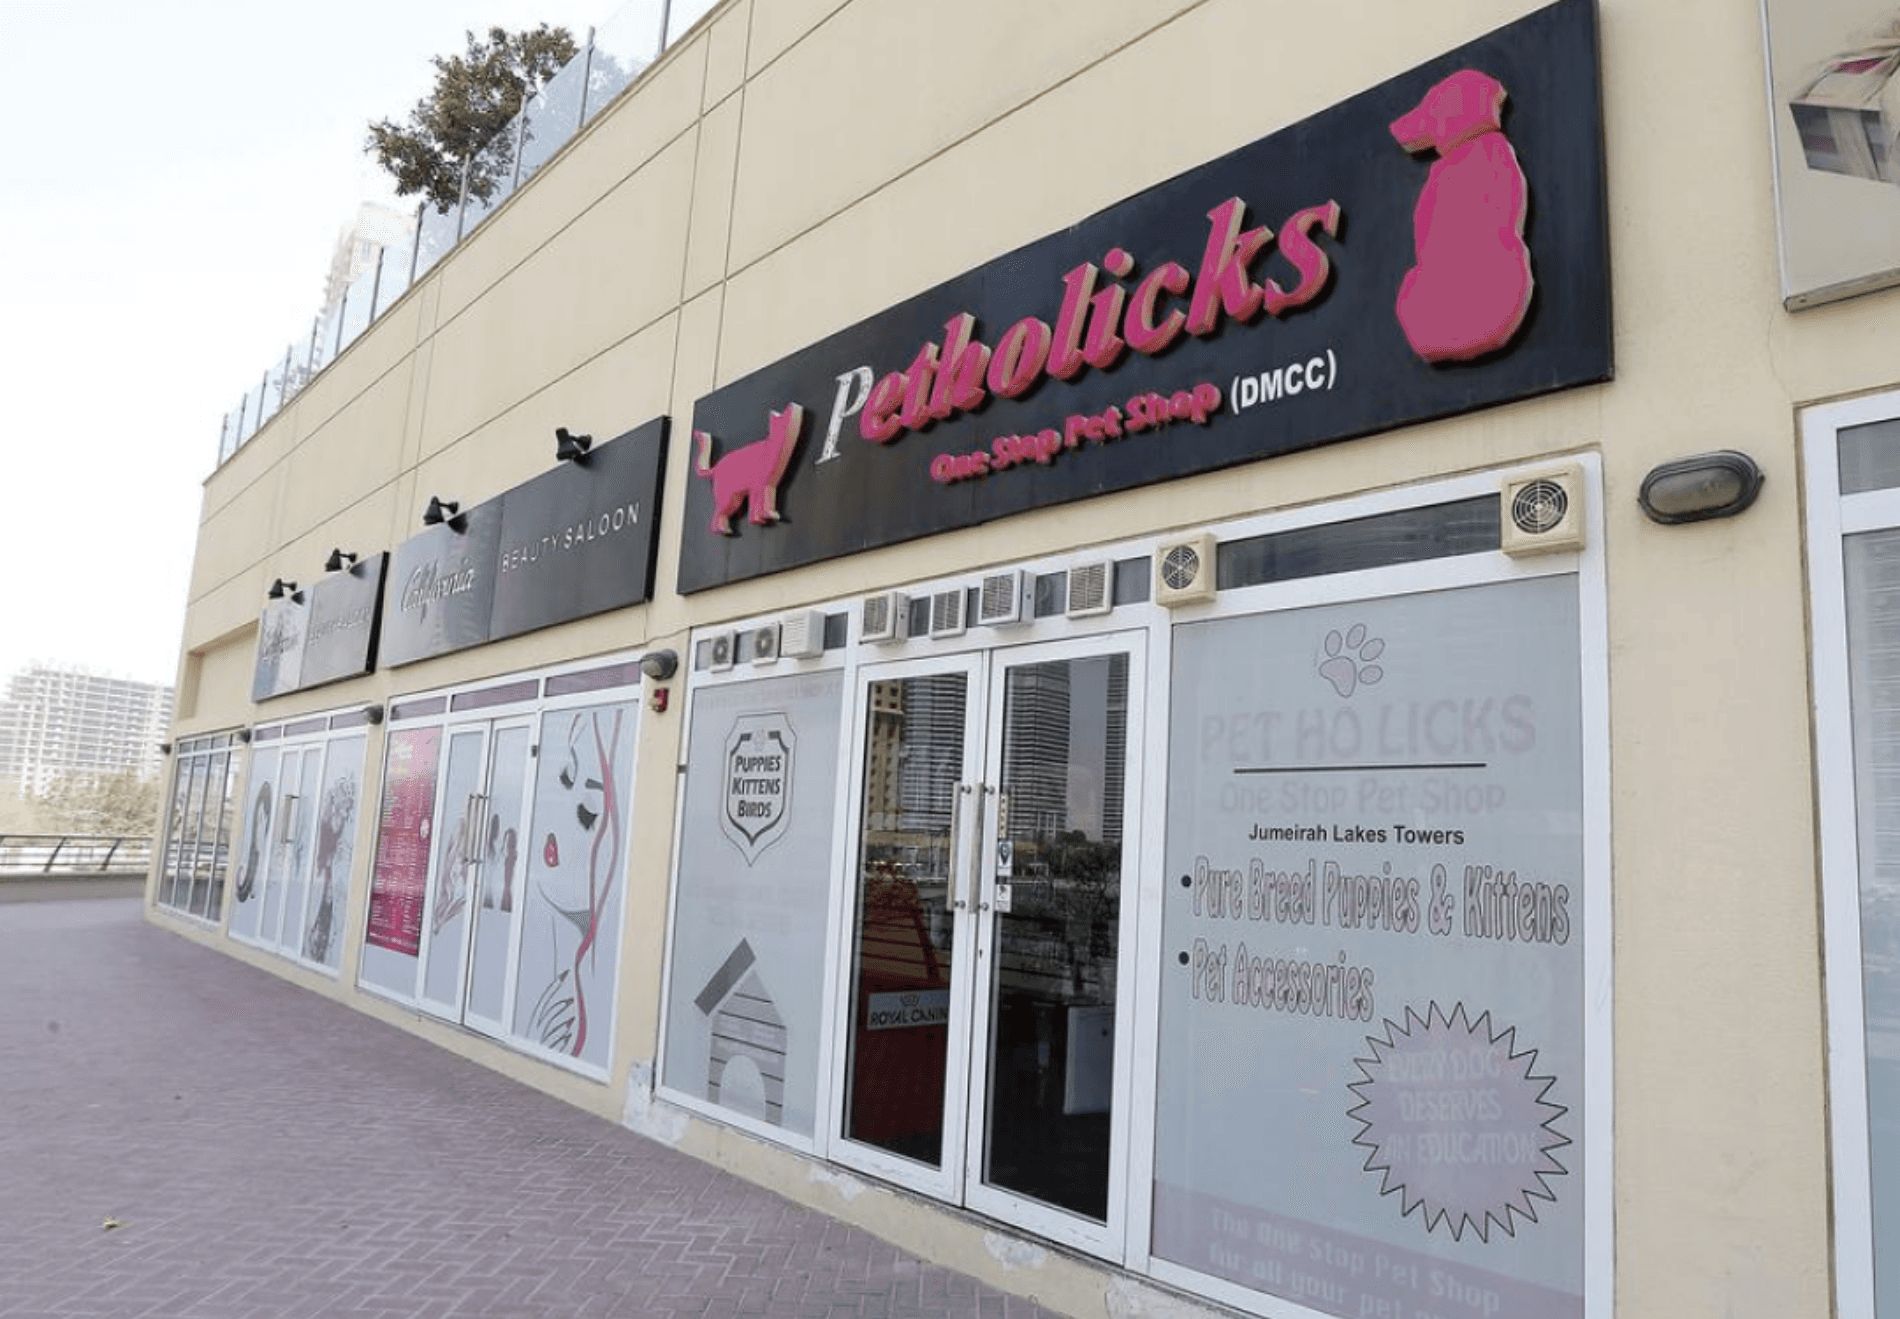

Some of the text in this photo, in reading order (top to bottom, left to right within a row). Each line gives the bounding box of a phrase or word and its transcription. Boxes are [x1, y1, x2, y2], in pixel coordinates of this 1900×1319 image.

[815, 196, 1340, 465] Petholicks
[930, 453, 989, 482] One
[1064, 404, 1123, 447] Pet
[1124, 383, 1221, 432] Shop
[1230, 348, 1336, 415] (DMCC)
[501, 501, 641, 573] BEAUTY SALOON
[1201, 693, 1537, 763] PET HO LICKS
[731, 777, 780, 795] KITTENS
[734, 755, 781, 772] PUPPIES
[1220, 777, 1507, 817] One Stop Pet Shop
[737, 800, 772, 818] BIRDS
[1248, 824, 1465, 846] Jumeirah Lakes Towers
[1192, 856, 1571, 946] Pure Breed Puppies & Kittens
[1192, 937, 1375, 1023] Pet Accessories
